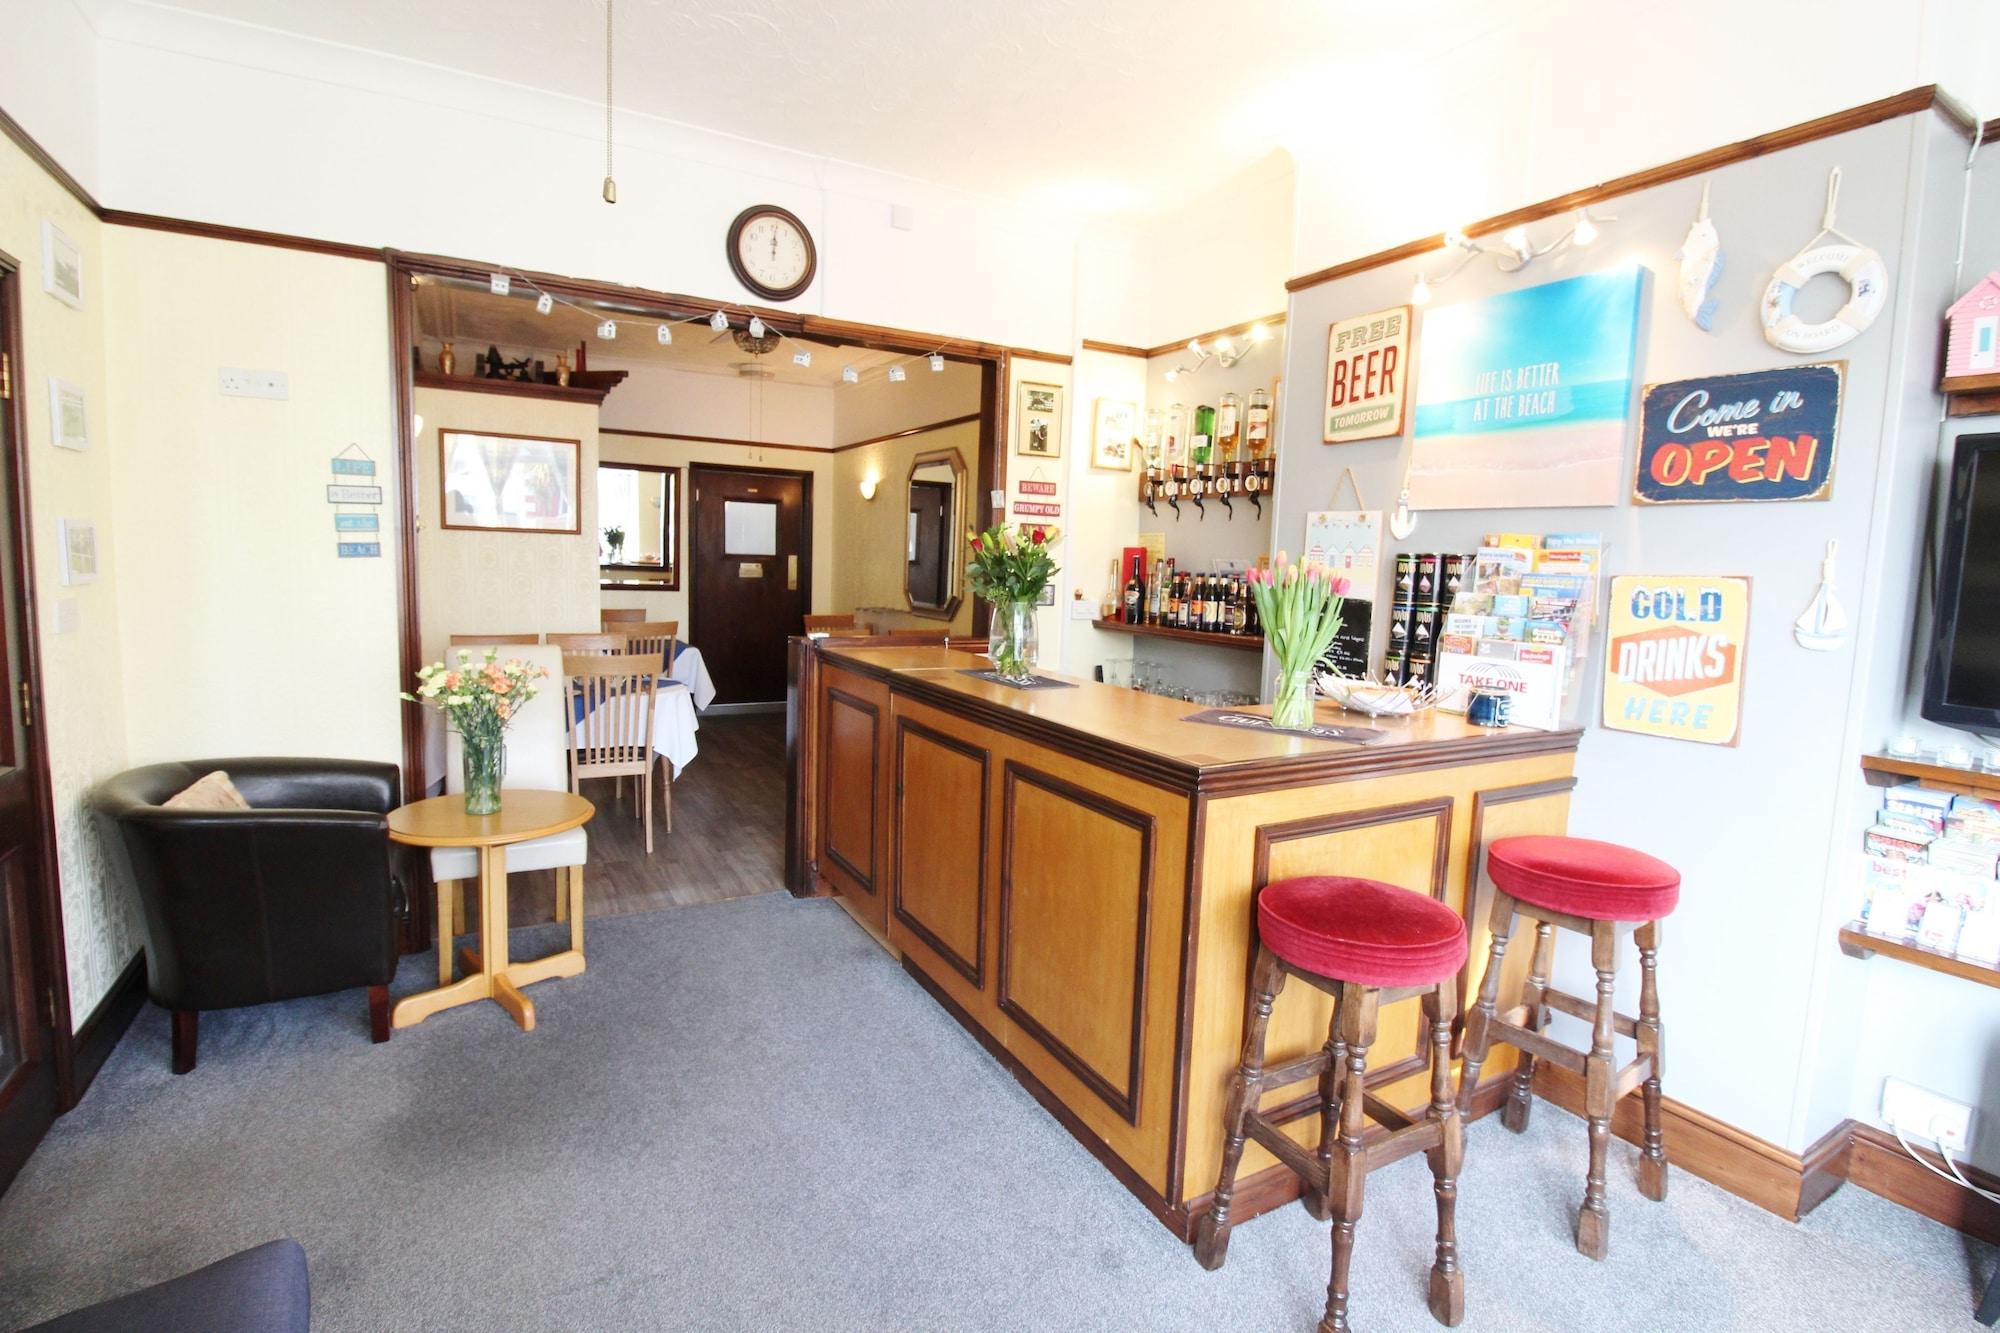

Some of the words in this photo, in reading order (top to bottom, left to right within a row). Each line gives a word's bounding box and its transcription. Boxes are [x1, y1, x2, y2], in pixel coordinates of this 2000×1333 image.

[1335, 314, 1402, 352] FREE
[1331, 345, 1397, 407] BEER
[1474, 371, 1498, 394] LIFE
[1500, 368, 1513, 391] IS
[1516, 362, 1560, 390] BETTER
[1334, 406, 1390, 429] TOMORROW
[1473, 399, 1490, 422] AT
[1494, 394, 1515, 419] THE
[1517, 390, 1557, 417] BEACH
[1666, 390, 1760, 434] Come
[1769, 390, 1804, 413] in
[1707, 422, 1759, 438] WE'RE
[1651, 435, 1818, 486] OPEN
[1021, 483, 1056, 494] BEWARE
[1014, 503, 1045, 514] GRUMPY
[1045, 505, 1060, 515] OLD
[1631, 586, 1722, 622] COLD
[1617, 634, 1729, 683] DRINKS
[1458, 673, 1493, 688] TAKE
[1496, 678, 1528, 693] ONE
[1624, 696, 1715, 730] HERE
